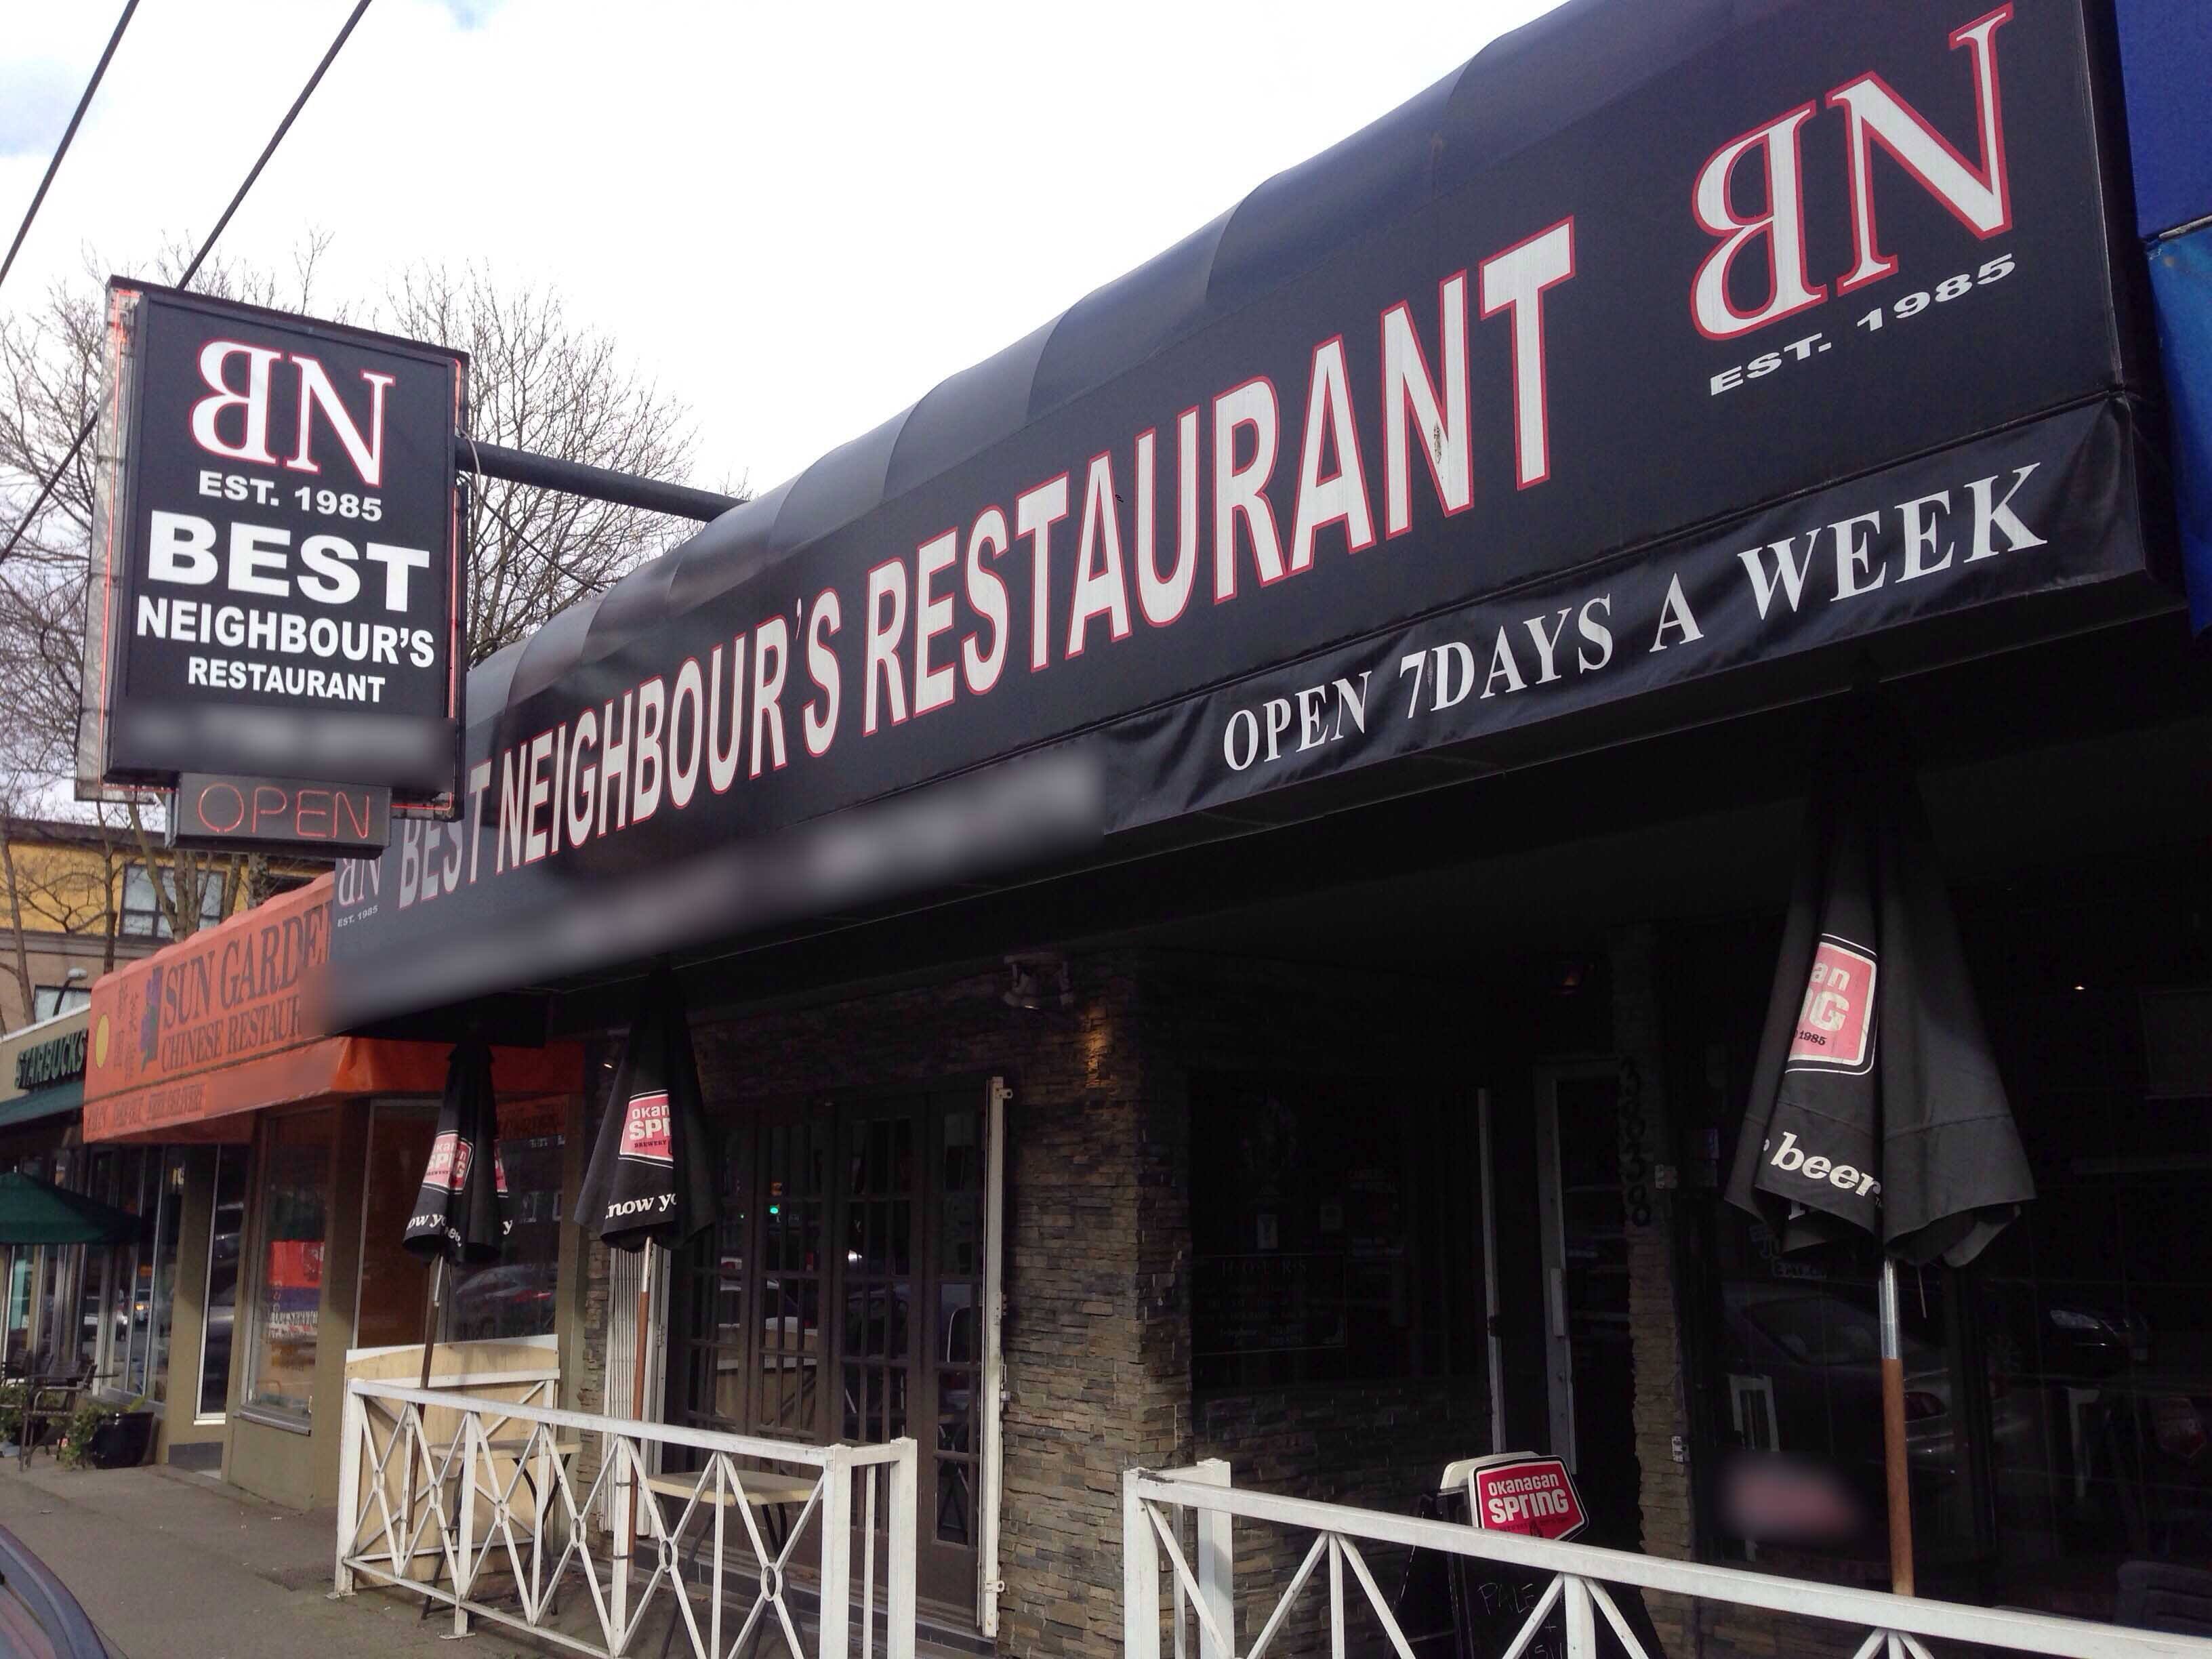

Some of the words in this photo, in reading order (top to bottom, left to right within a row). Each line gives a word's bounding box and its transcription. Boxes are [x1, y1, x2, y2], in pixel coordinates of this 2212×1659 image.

[1710, 333, 1832, 396] EST.
[1856, 253, 2016, 333] 1985
[199, 470, 279, 506] EST.
[294, 487, 382, 522] 1985
[148, 510, 430, 613] BEST
[398, 758, 492, 910] BEST
[495, 587, 841, 876] NEIGHBOUR'S
[863, 215, 1575, 737] RESTAURANT
[137, 596, 434, 669] NEIGHBOUR'S
[1223, 671, 1372, 773] OPEN
[1650, 573, 1704, 653] A
[1737, 463, 2048, 621] WEEK
[188, 657, 386, 703] RESTAURANT
[197, 781, 370, 839] OPEN
[337, 916, 356, 928] EST.
[357, 905, 378, 920] 1985
[163, 949, 216, 1029] SUN
[15, 1028, 88, 1088] STARBUCKS
[161, 1019, 224, 1072] CHINESE
[1799, 1031, 1828, 1046] 1985
[1770, 1131, 1881, 1197] beer
[605, 1197, 654, 1220] now
